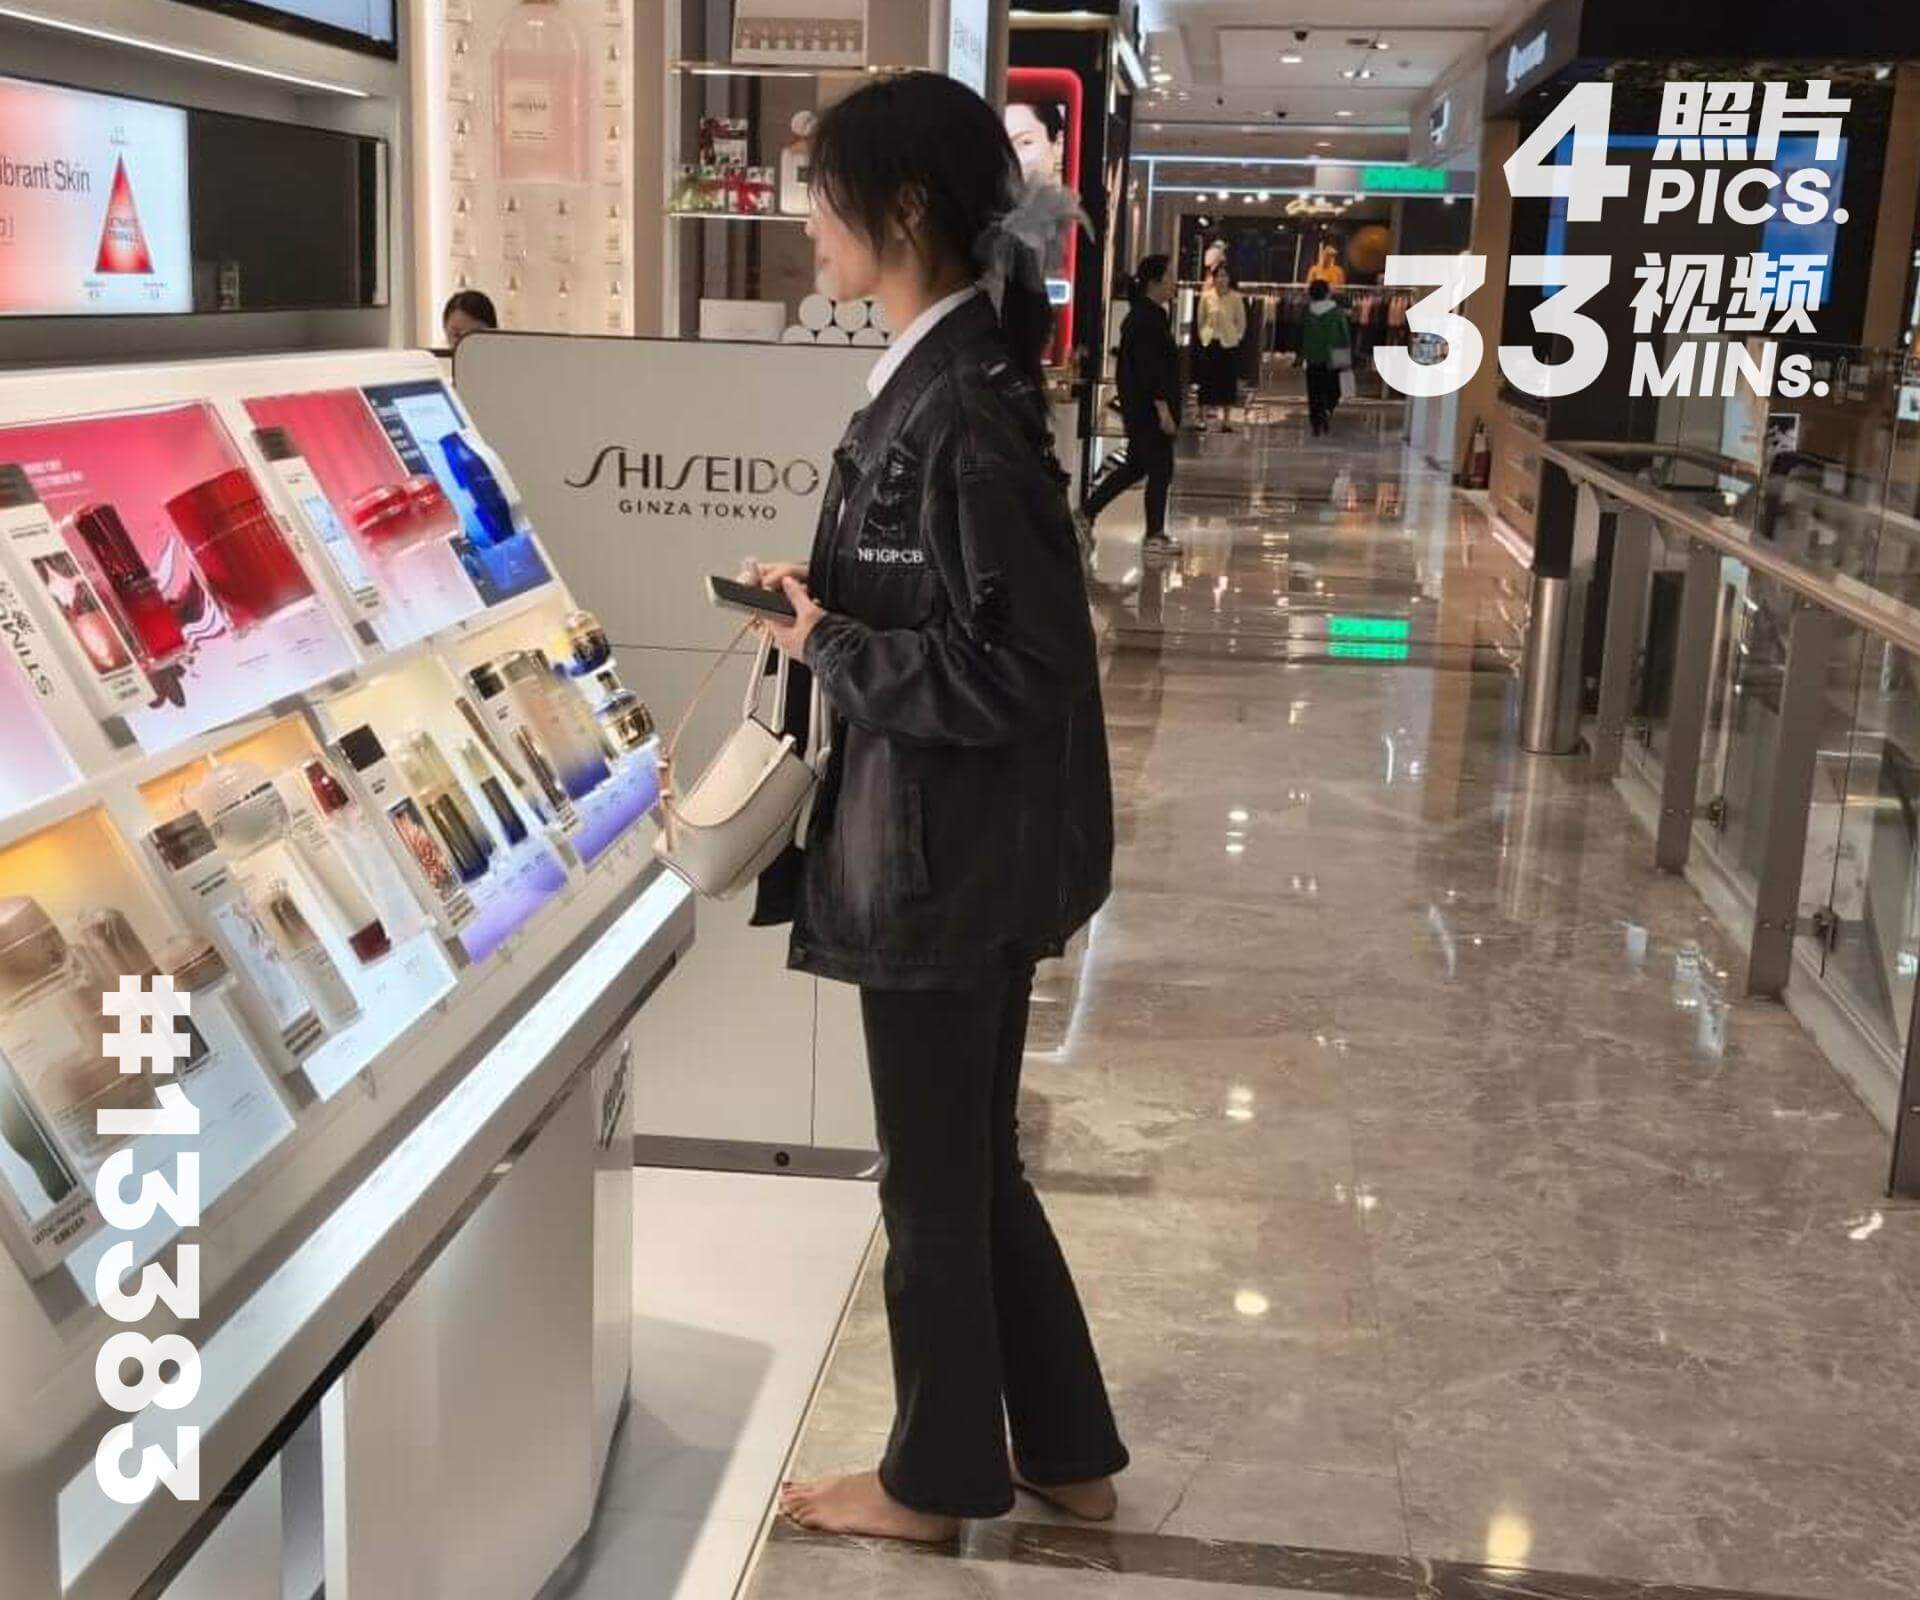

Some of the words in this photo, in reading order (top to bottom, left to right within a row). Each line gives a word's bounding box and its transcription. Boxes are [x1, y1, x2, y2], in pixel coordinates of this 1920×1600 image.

[53, 160, 91, 193] Skin
[564, 446, 819, 496] SHISEIDO
[618, 500, 692, 516] GINZA
[700, 503, 777, 520] TOKYO
